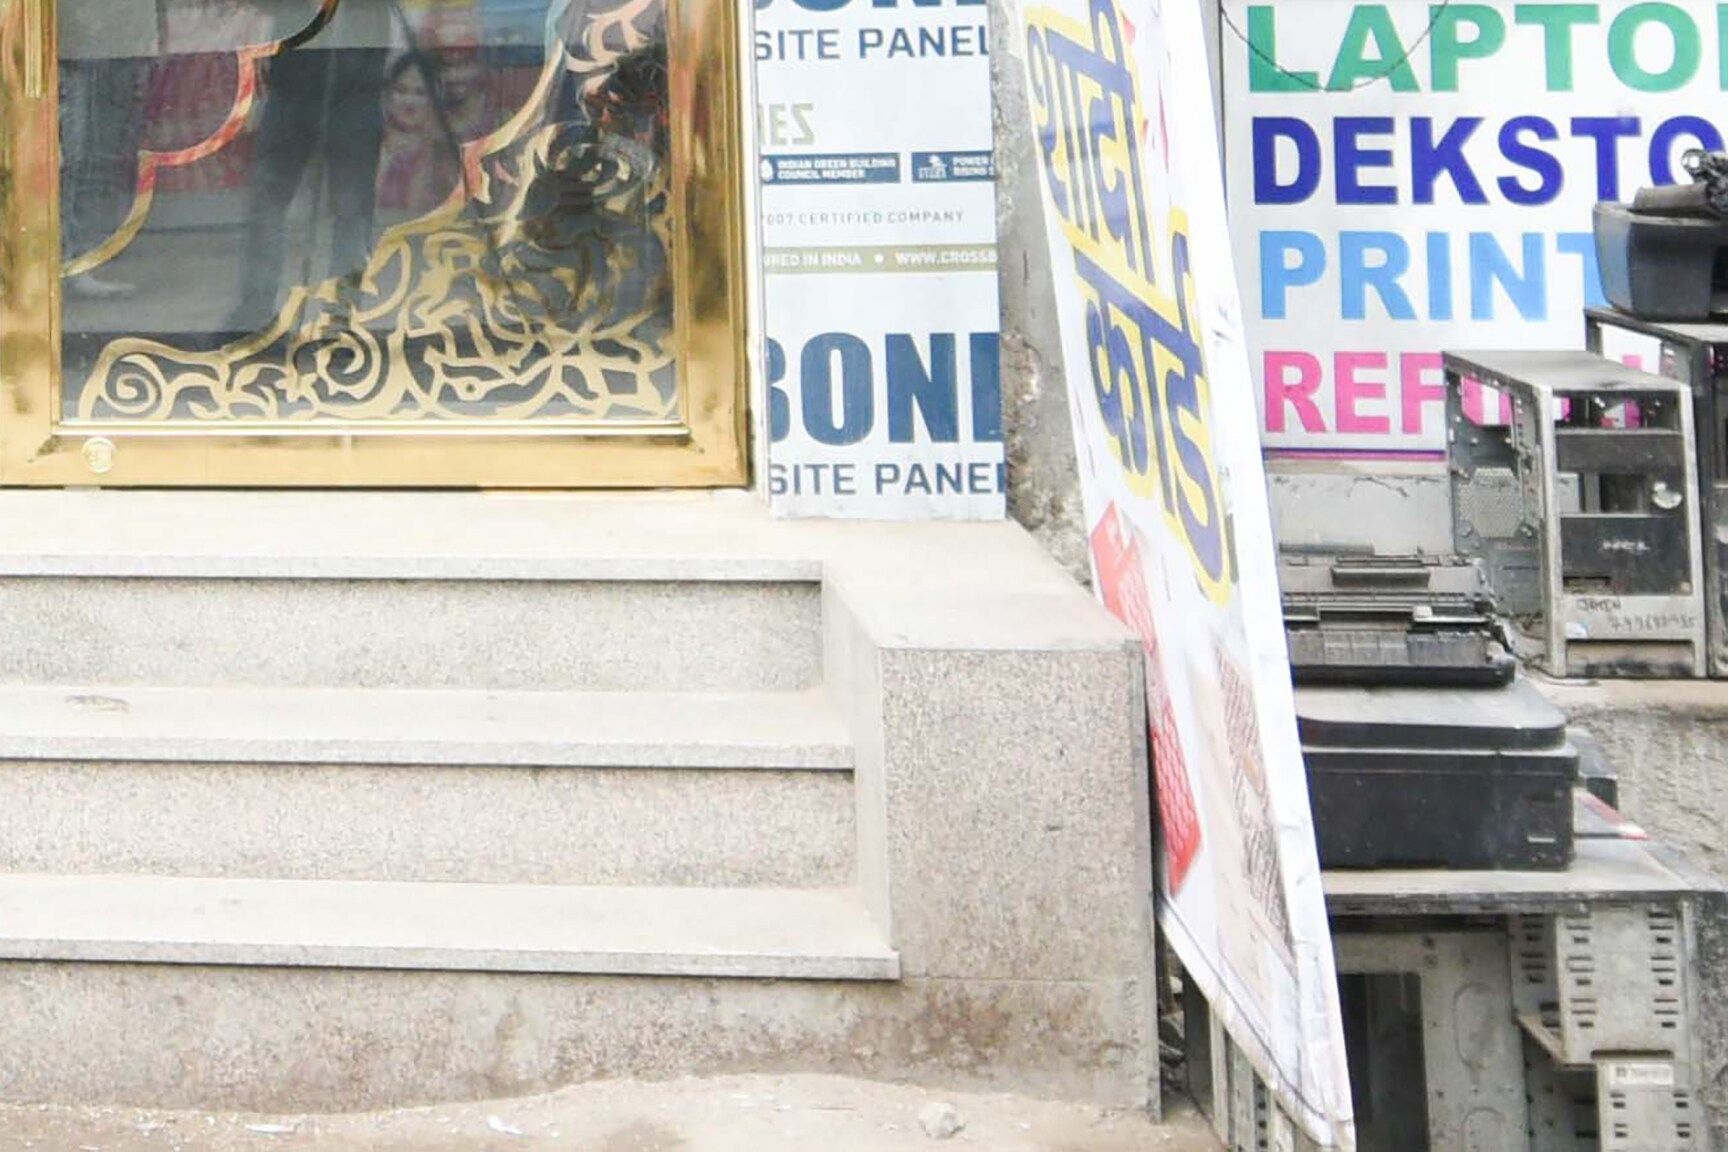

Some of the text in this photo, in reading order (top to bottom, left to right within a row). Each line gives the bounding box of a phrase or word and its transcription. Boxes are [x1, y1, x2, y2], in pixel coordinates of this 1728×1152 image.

[1246, 2, 1728, 93] LAPTO
[798, 211, 882, 225] CERTIFIED
[887, 210, 965, 225] COMPANY
[769, 463, 856, 496] SITE
